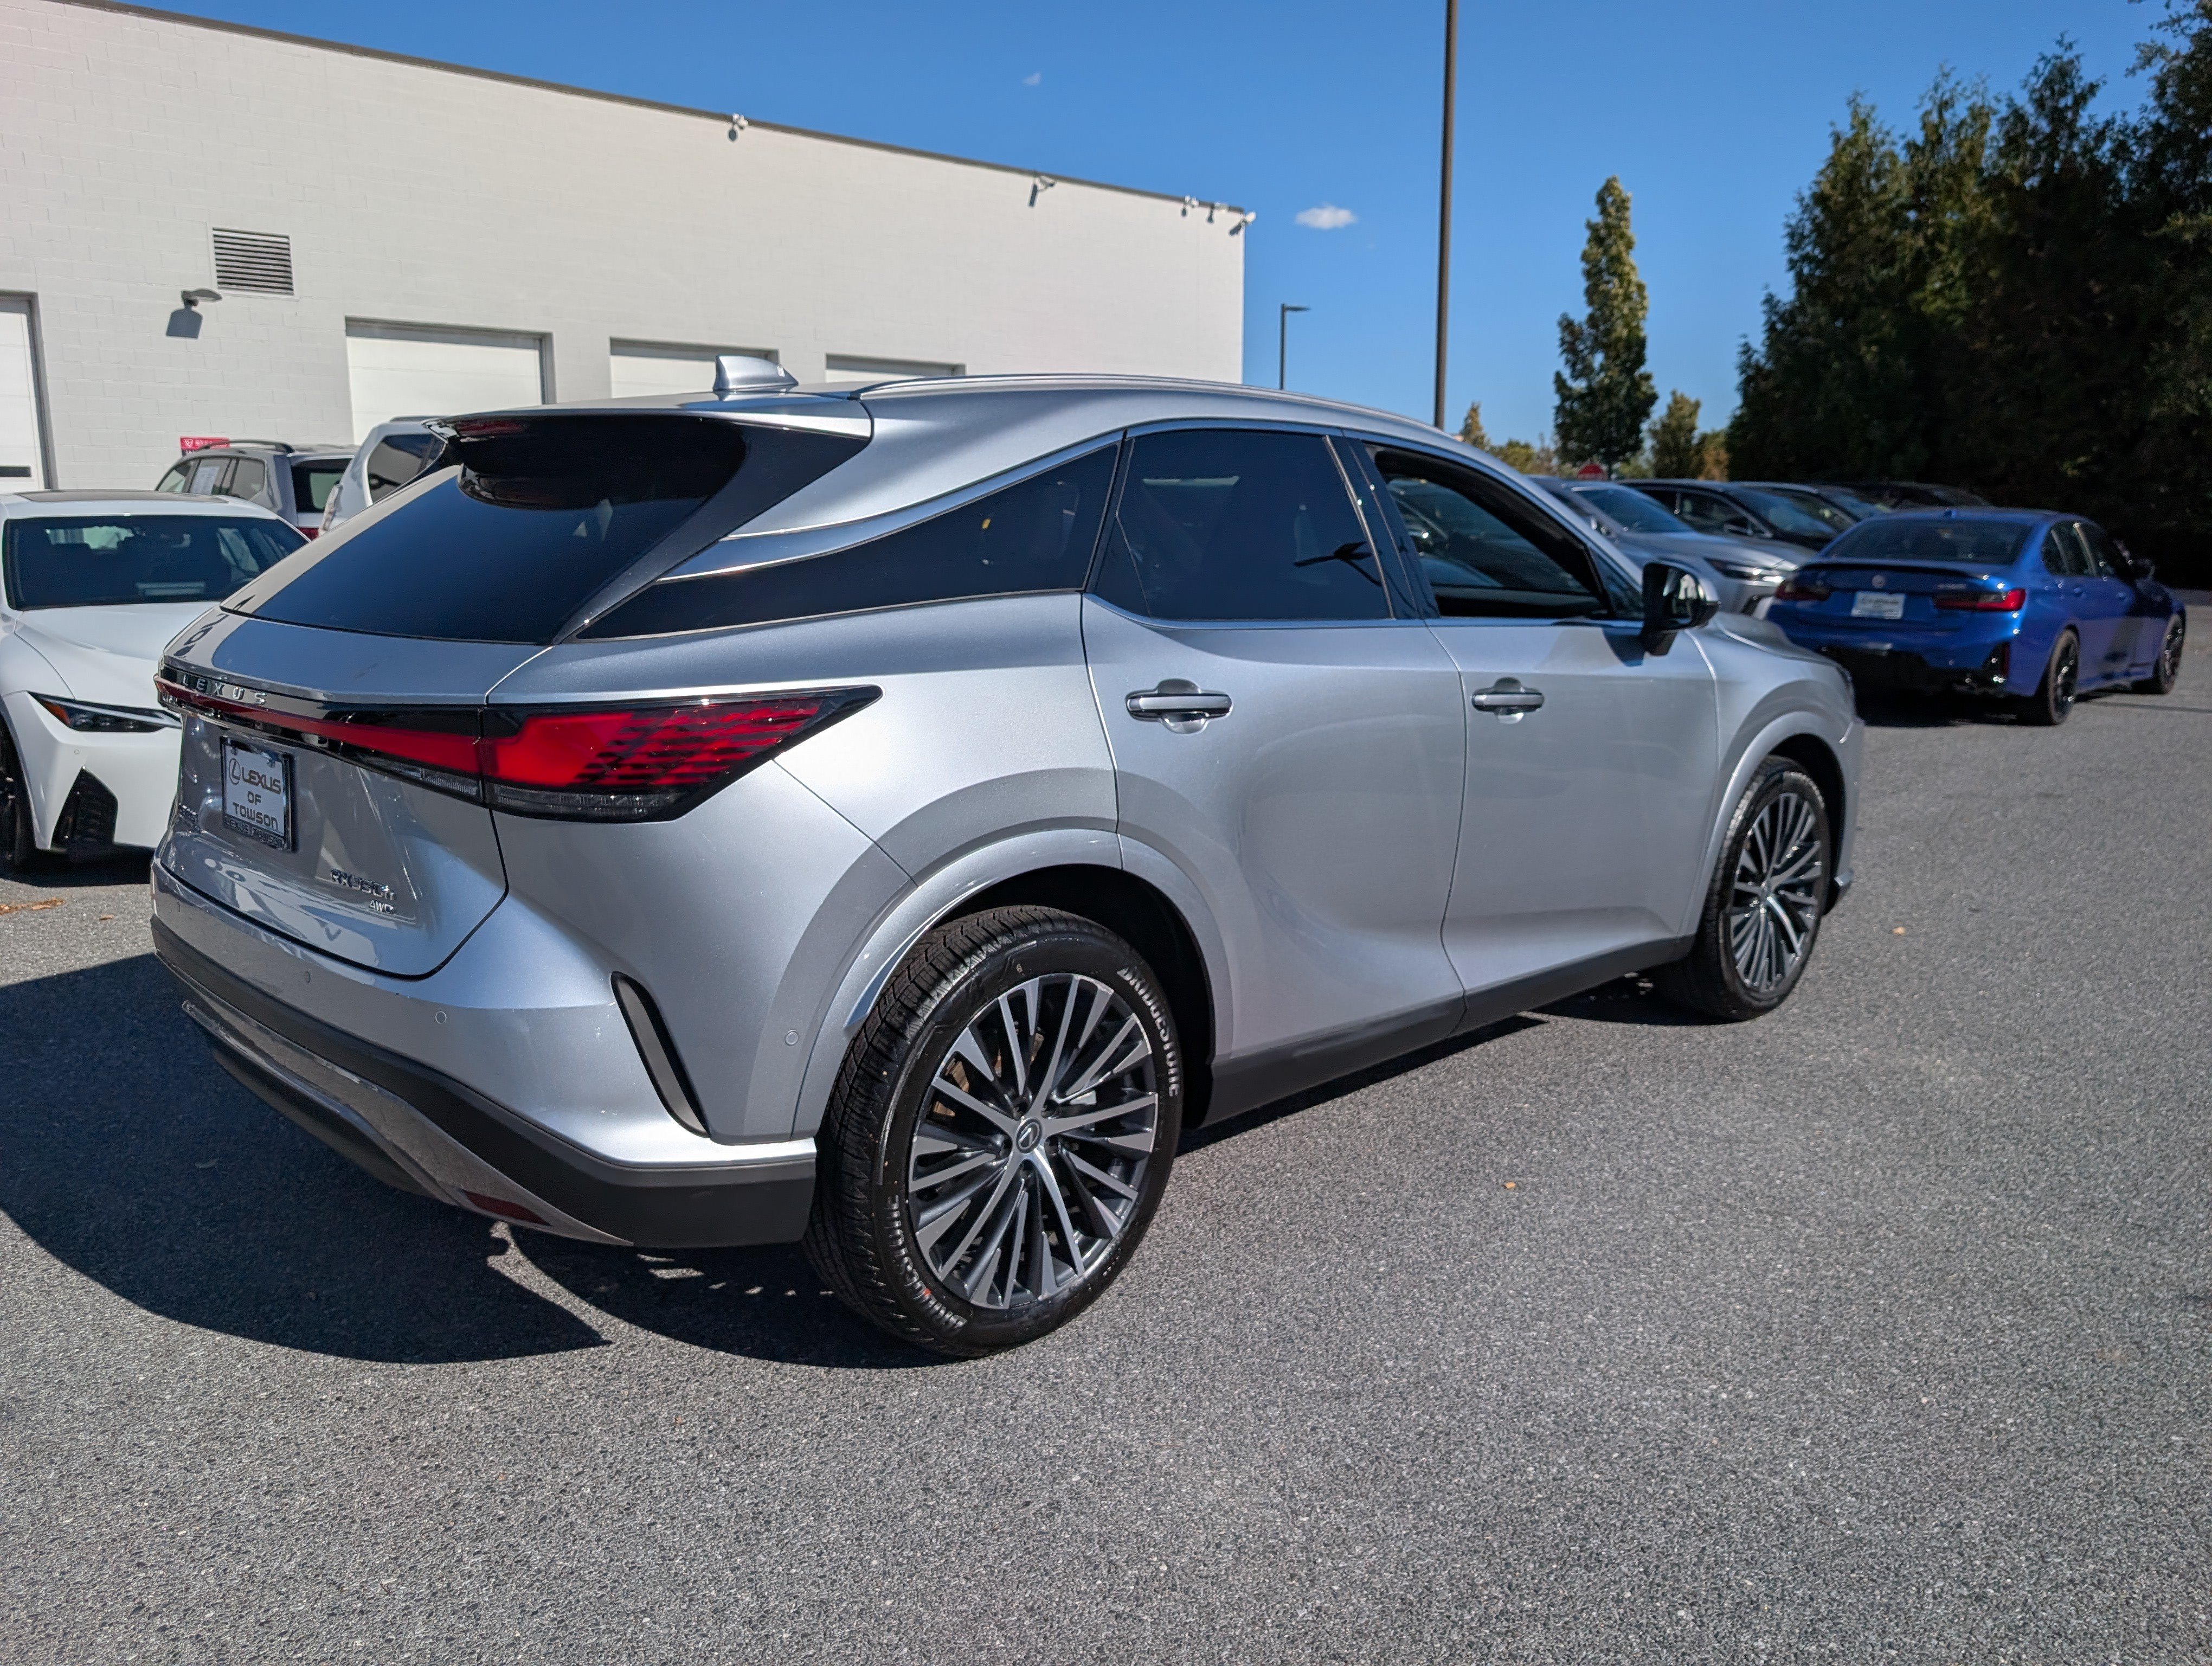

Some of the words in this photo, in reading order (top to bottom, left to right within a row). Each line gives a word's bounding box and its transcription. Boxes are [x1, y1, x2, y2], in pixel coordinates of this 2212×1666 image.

[182, 674, 267, 705] LEXUS
[242, 766, 282, 794] LEXUS
[247, 791, 262, 805] OF
[233, 802, 279, 831] TOWSON
[369, 900, 395, 913] AWD
